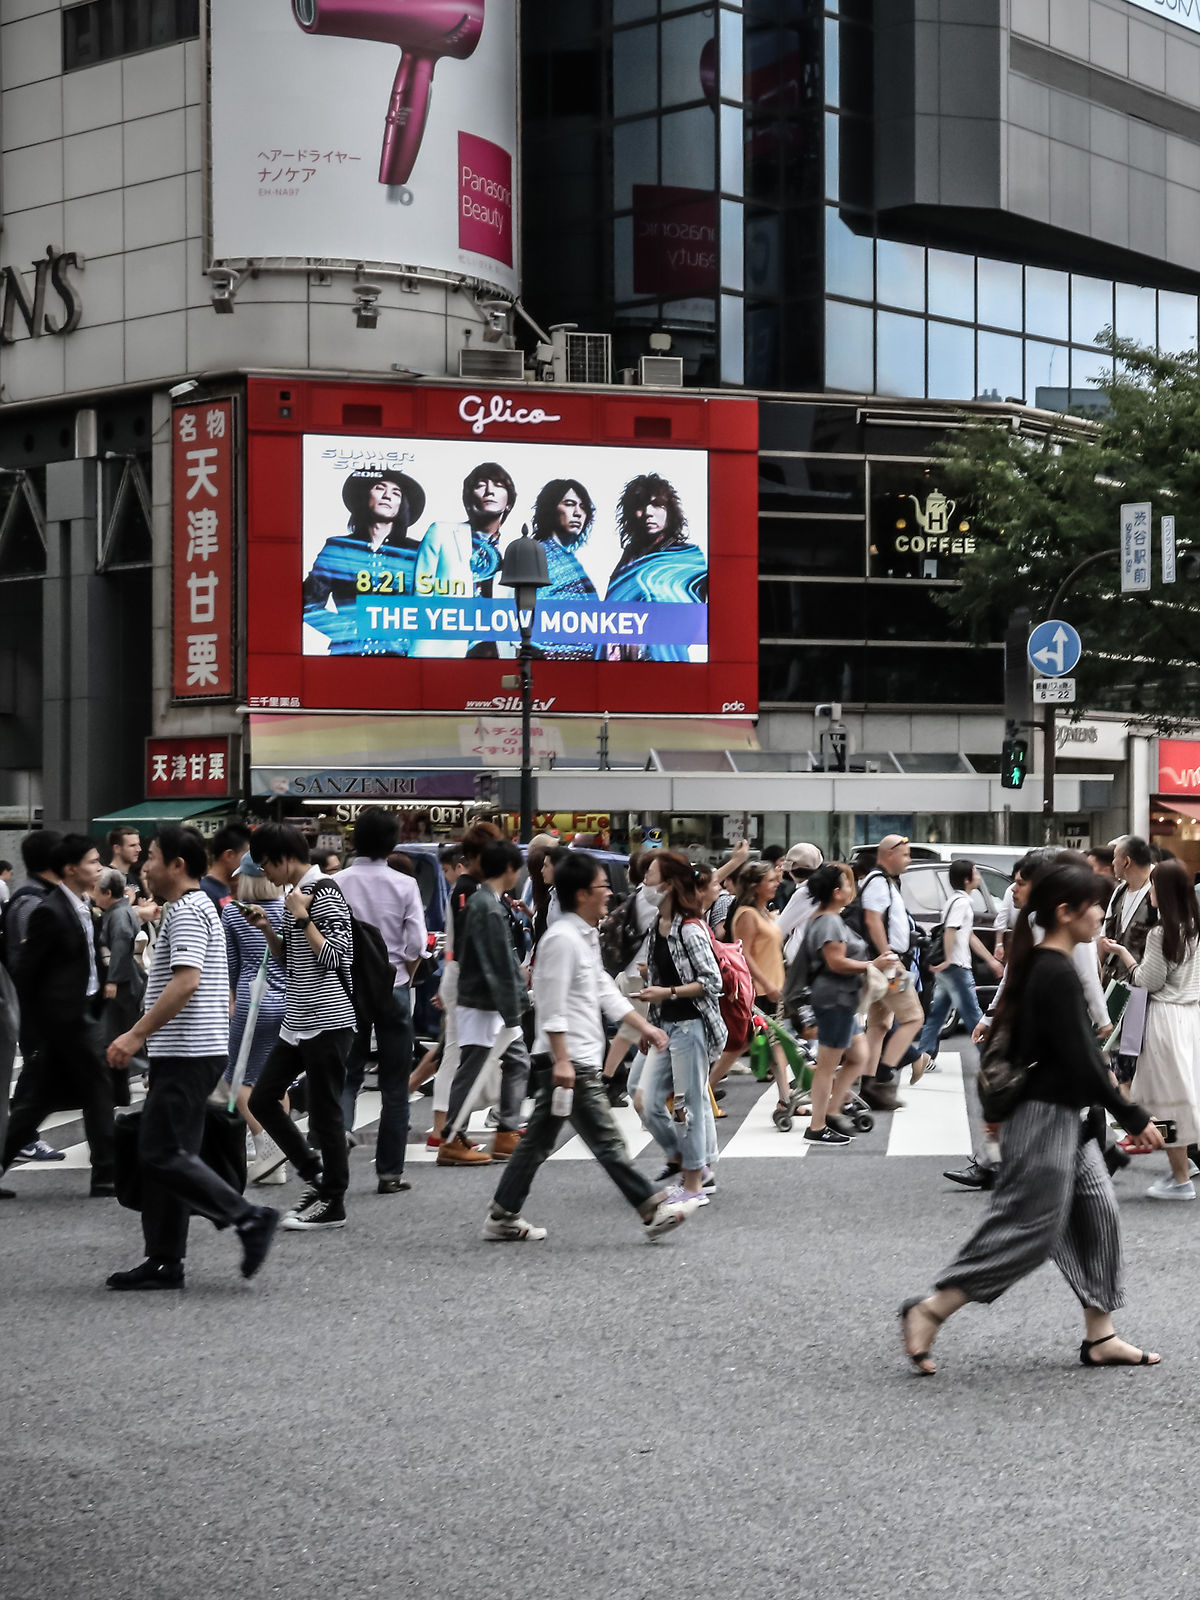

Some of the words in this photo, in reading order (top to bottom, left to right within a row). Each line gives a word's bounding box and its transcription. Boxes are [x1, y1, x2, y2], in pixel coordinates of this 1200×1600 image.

[258, 149, 362, 164] ヘアードライヤー
[257, 167, 317, 183] ナノケア
[462, 165, 512, 208] Panasonic
[462, 194, 504, 235] Beauty
[0, 245, 85, 345] N'S
[179, 409, 226, 443] 名物
[458, 394, 561, 434] Glico
[332, 460, 404, 472] SONIC
[895, 534, 976, 554] COFFEE
[1125, 522, 1133, 556] Shibuya
[1133, 511, 1147, 584] 渋谷駅前
[185, 447, 219, 687] 天津甘栗
[356, 571, 406, 593] 8.21
[415, 572, 466, 595] Sun
[366, 606, 418, 630] THE
[425, 607, 533, 632] YELLOW
[541, 610, 649, 635] MONKEY
[250, 696, 300, 708] 三千里薬品
[722, 700, 745, 712] pdc
[503, 737, 518, 745] の
[152, 752, 225, 782] 天津甘栗
[294, 776, 417, 794] SANZENRI
[429, 806, 463, 823] OFF
